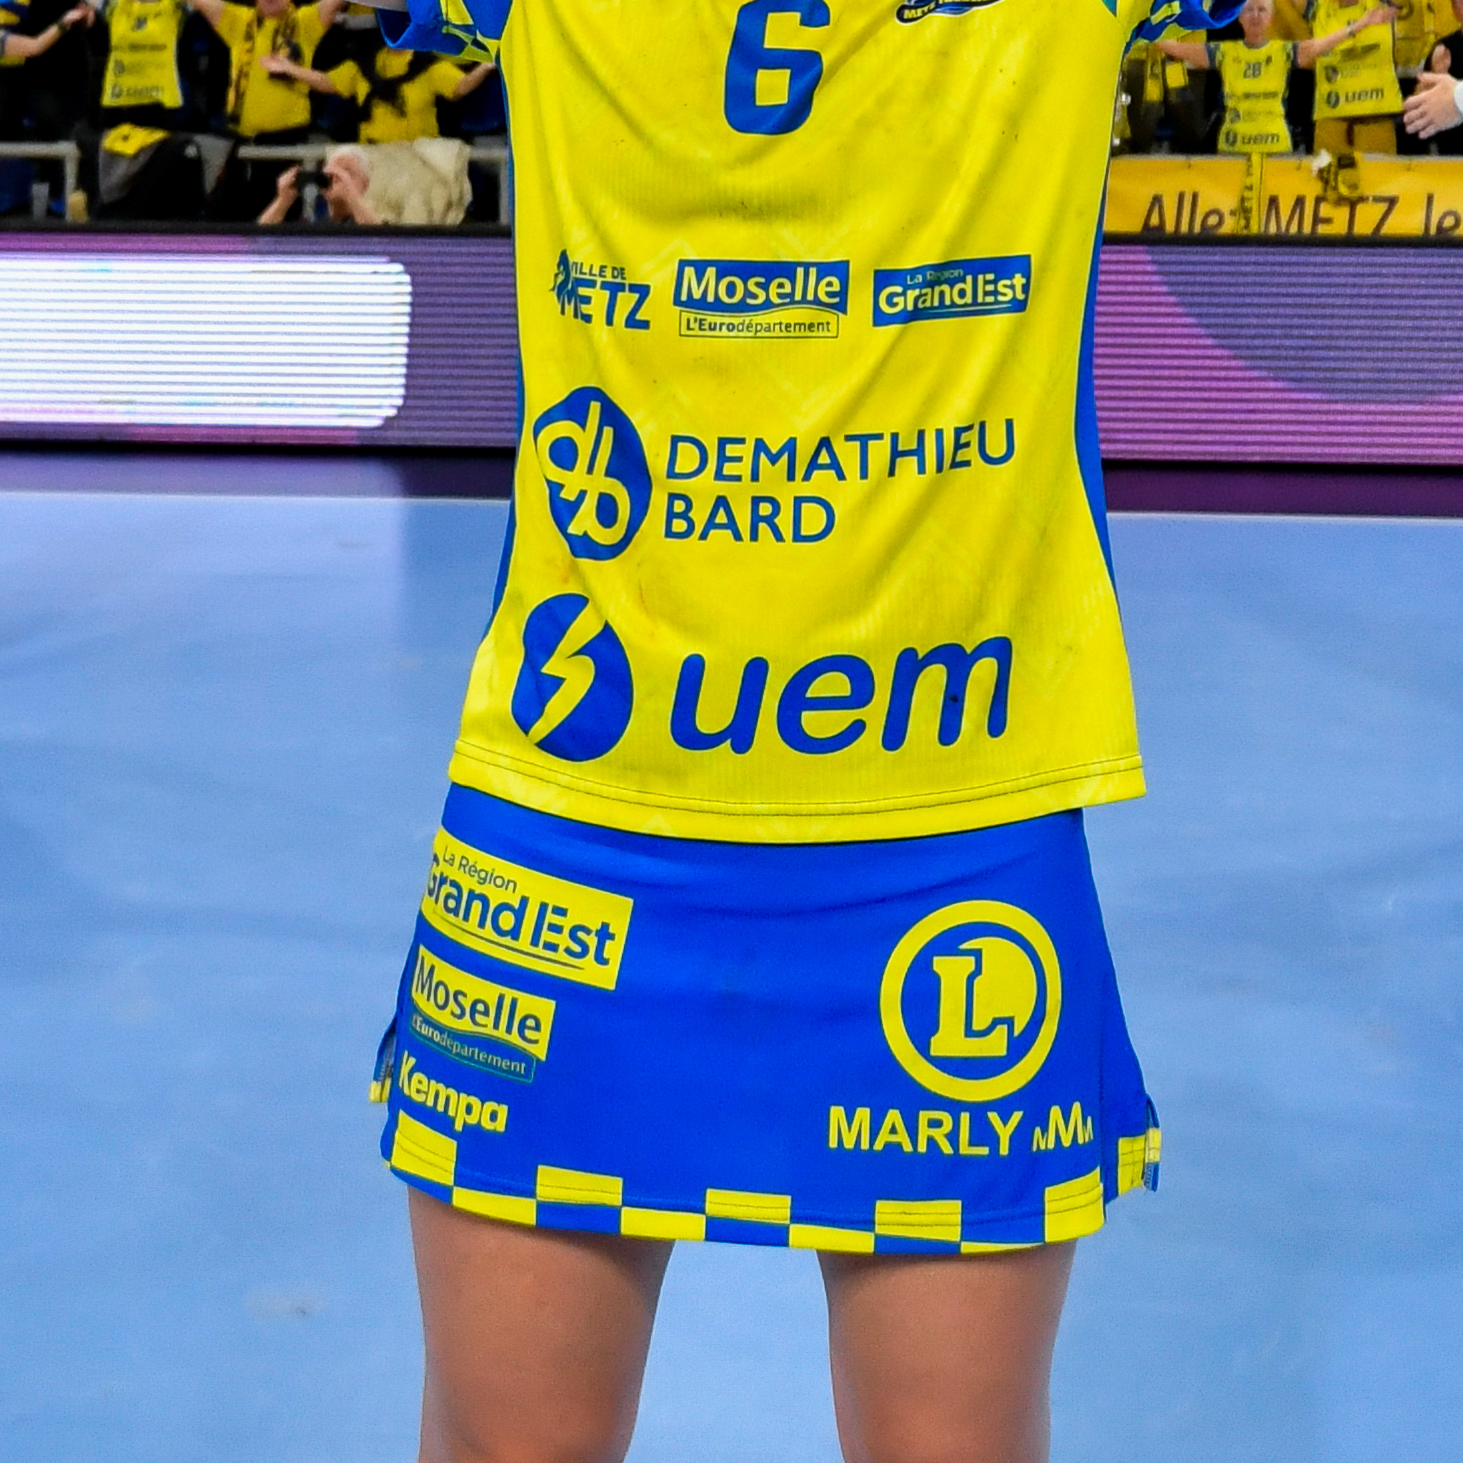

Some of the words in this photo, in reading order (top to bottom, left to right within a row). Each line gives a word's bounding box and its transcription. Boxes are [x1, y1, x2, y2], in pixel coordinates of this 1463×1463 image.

[1141, 190, 1240, 236] Alle
[610, 266, 627, 281] DE
[680, 266, 841, 306] Moselle
[686, 316, 831, 336] L'Eurodépartement
[667, 418, 1016, 481] DEMATHIEU
[665, 495, 836, 543] BARD
[670, 636, 1013, 755] uem
[442, 845, 456, 868] La
[457, 856, 518, 894] Région
[414, 954, 542, 1046] Moselle
[399, 1050, 509, 1133] Kempa
[829, 1104, 1024, 1157] MARLY
